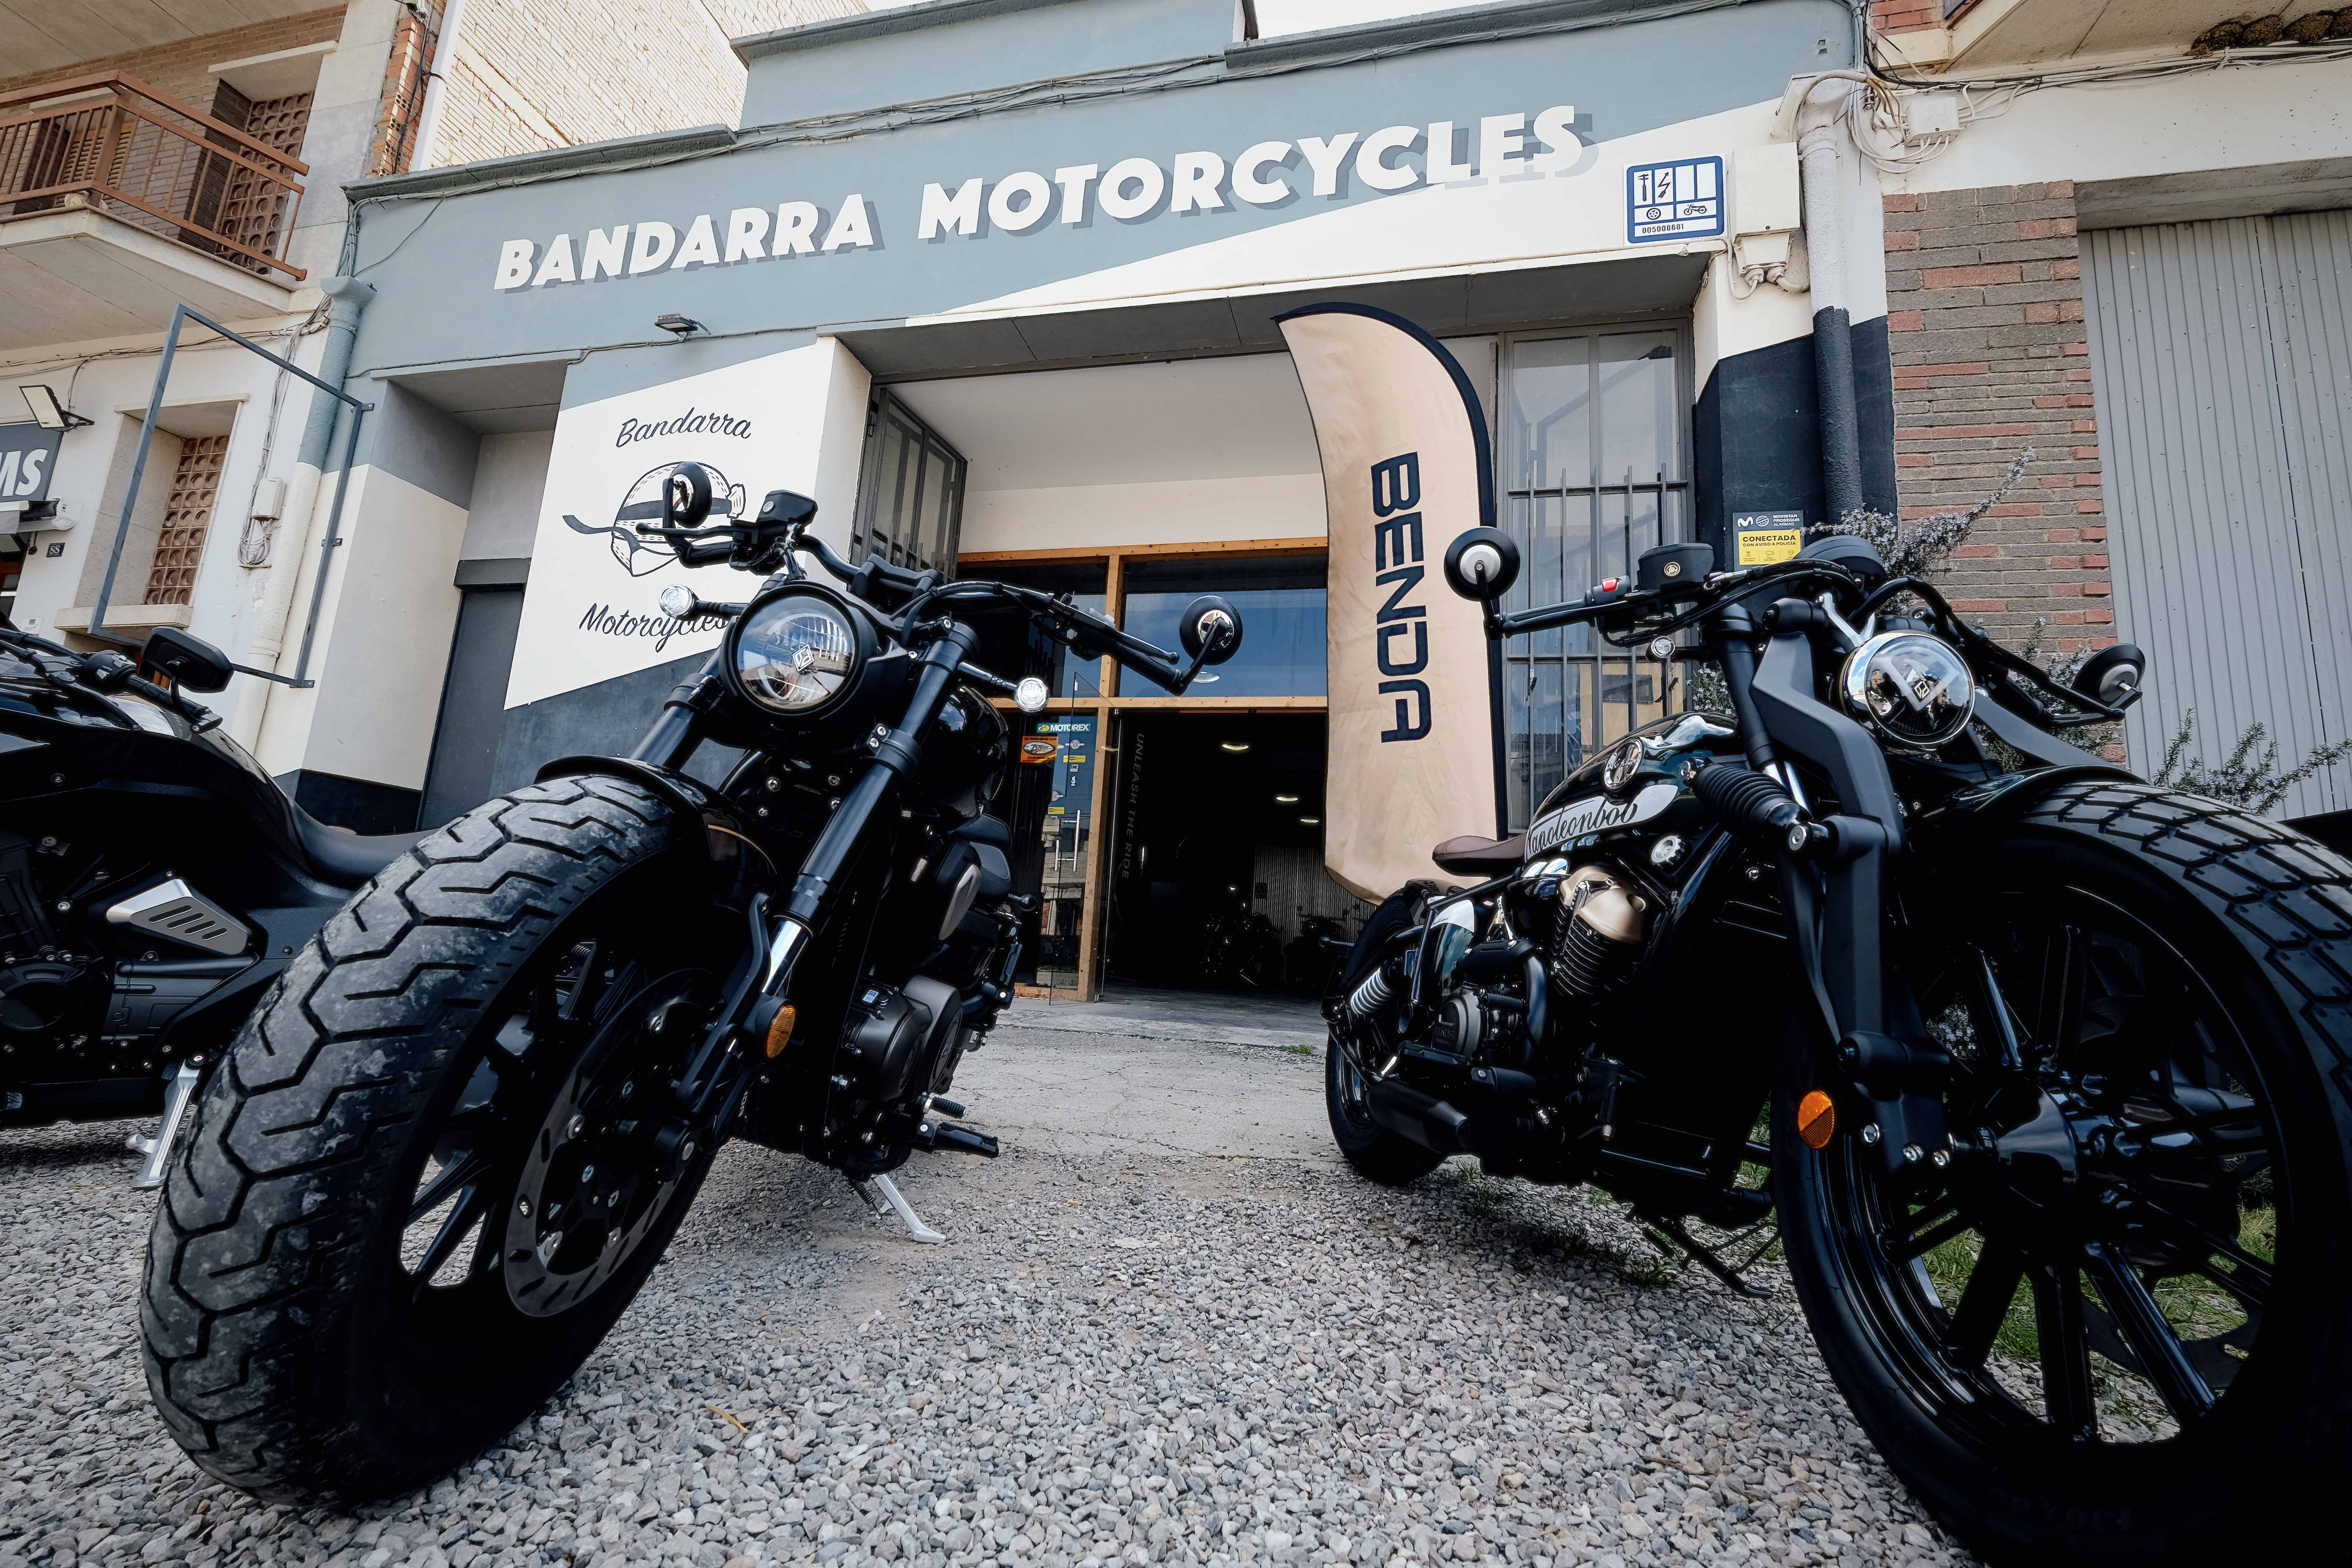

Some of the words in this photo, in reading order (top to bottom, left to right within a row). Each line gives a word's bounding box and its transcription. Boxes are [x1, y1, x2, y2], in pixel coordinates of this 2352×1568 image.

[493, 193, 874, 290] BANDARRA
[917, 105, 1583, 240] MOTORCYCLES
[1642, 223, 1684, 234] 005008681
[616, 407, 752, 448] Bandarra
[1370, 451, 1432, 744] BENDA
[1129, 733, 1145, 804] UNLEASH
[1127, 810, 1136, 837] THE
[1122, 842, 1132, 879] RIDE
